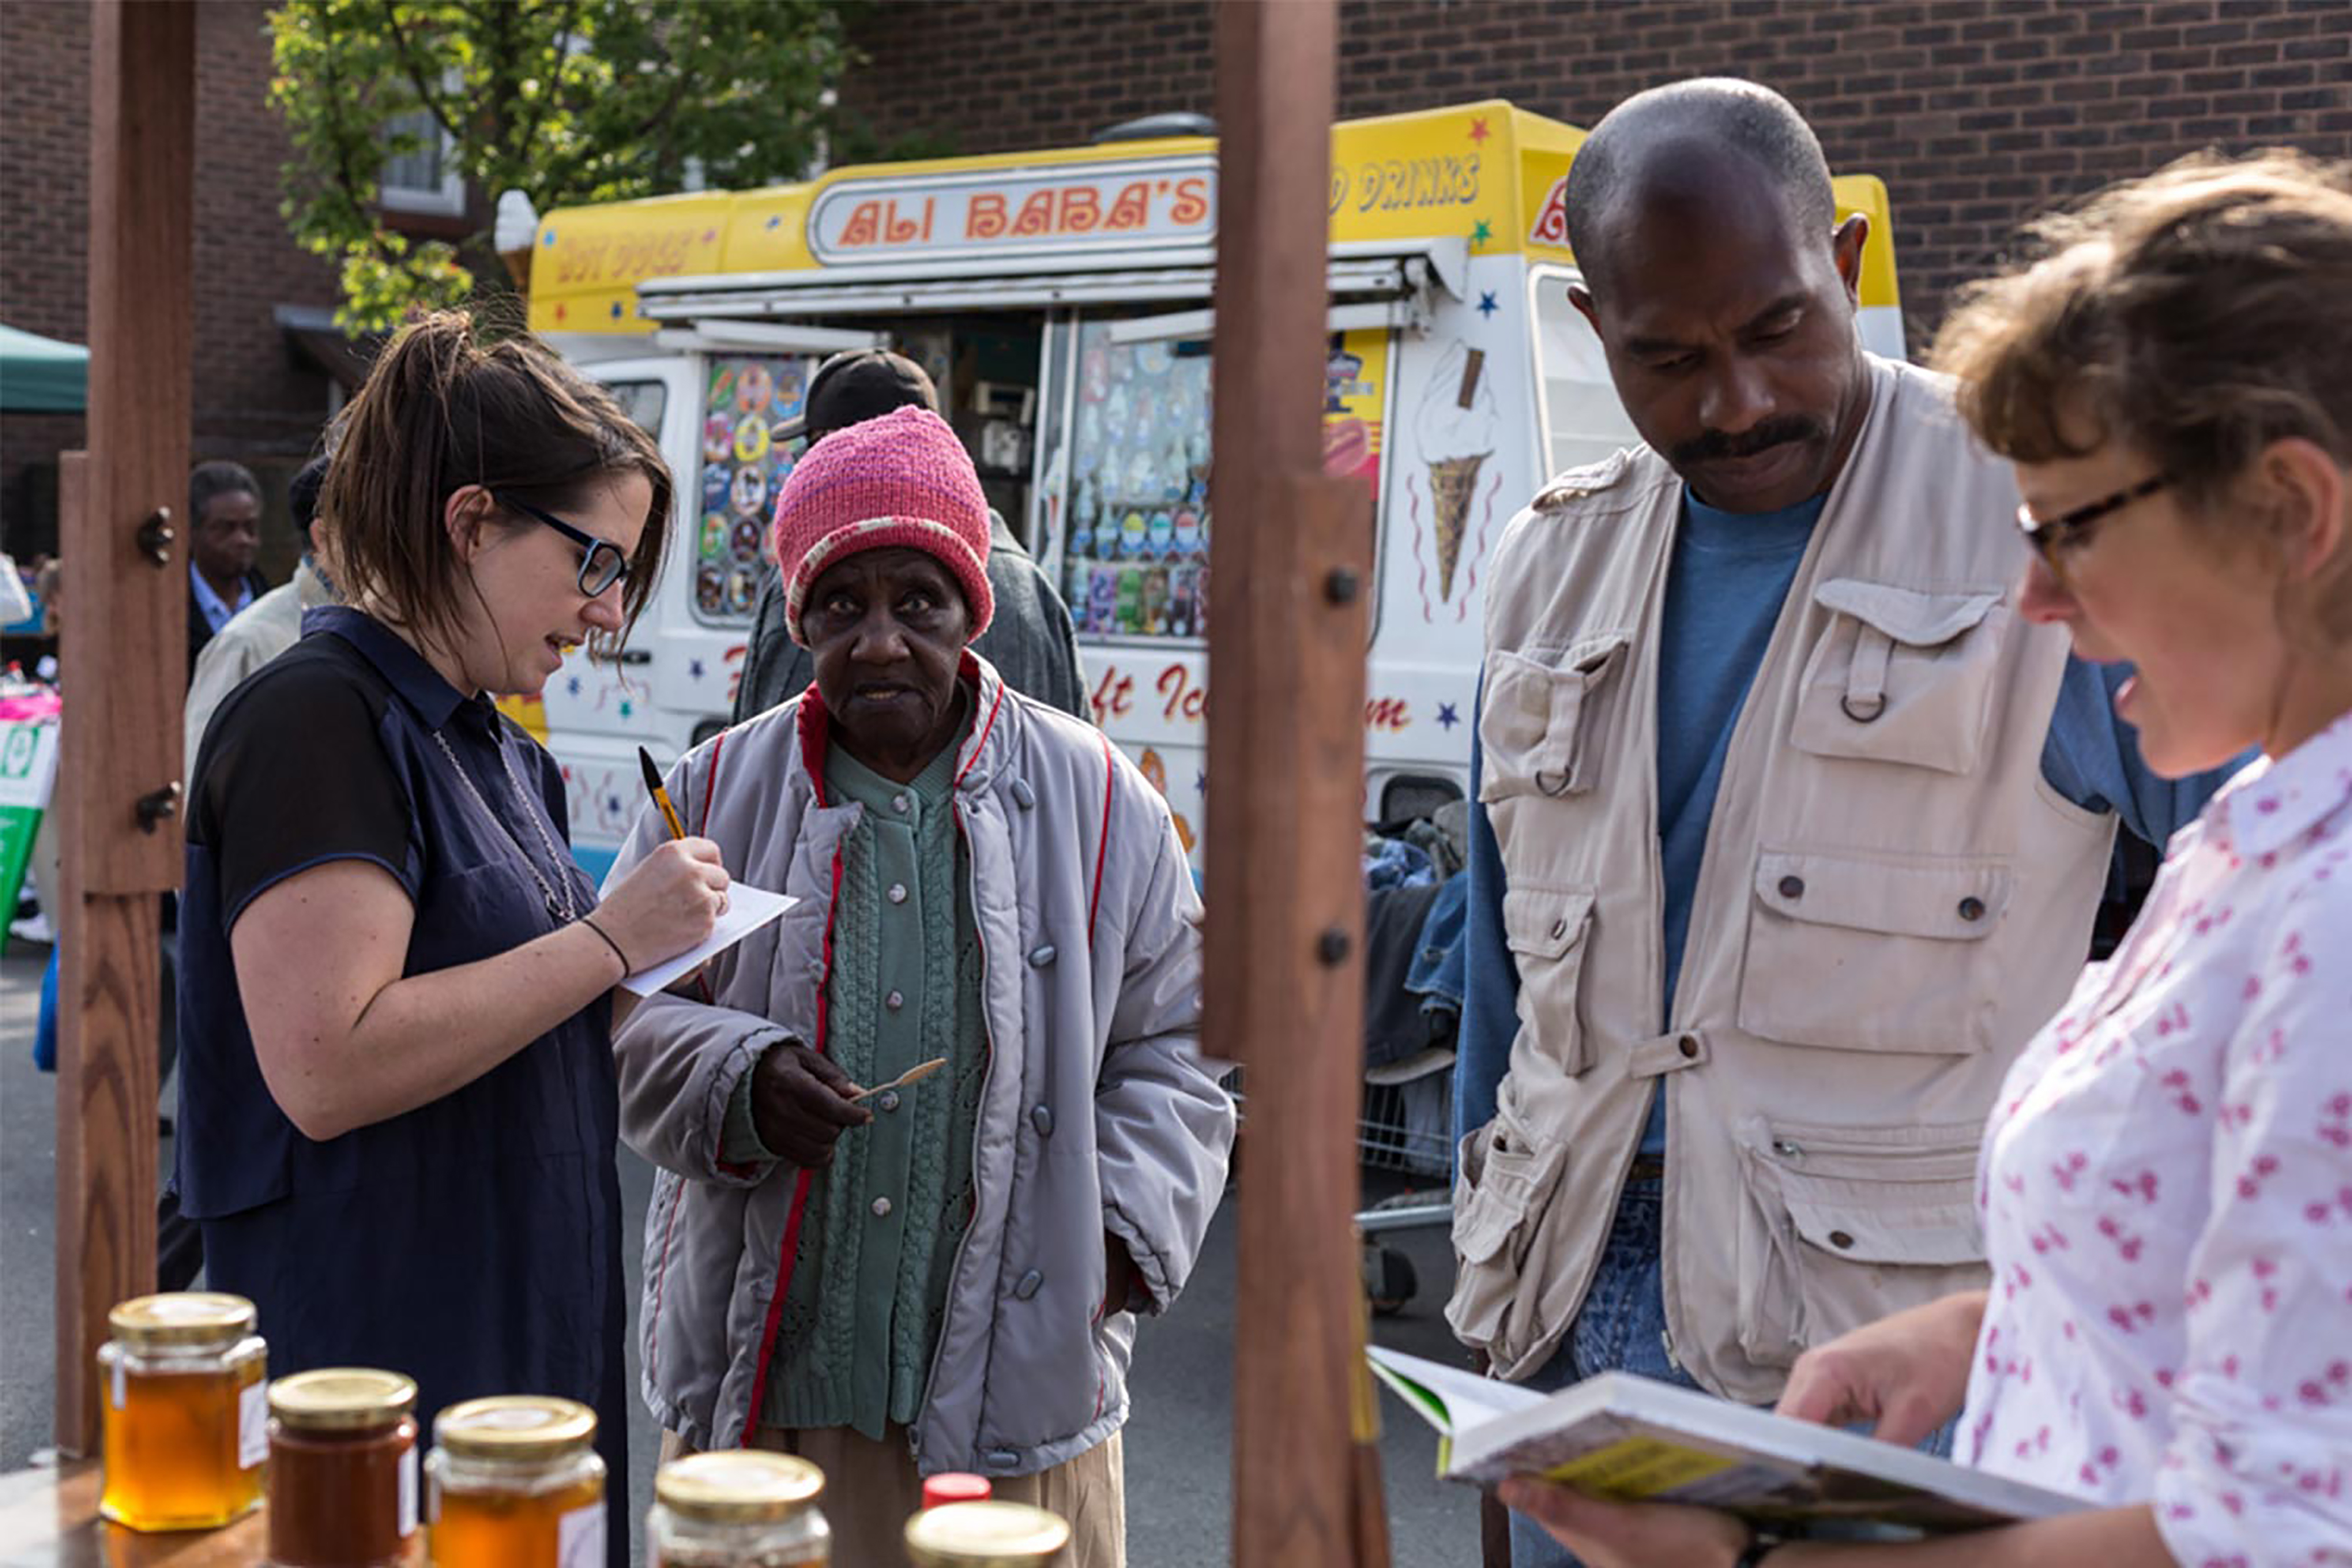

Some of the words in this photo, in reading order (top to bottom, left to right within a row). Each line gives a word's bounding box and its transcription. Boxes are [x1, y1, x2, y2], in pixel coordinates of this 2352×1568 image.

[837, 196, 936, 246] ALI
[965, 178, 1208, 239] BABA'S
[1359, 152, 1481, 213] DRINKS
[1091, 665, 1132, 725] ft
